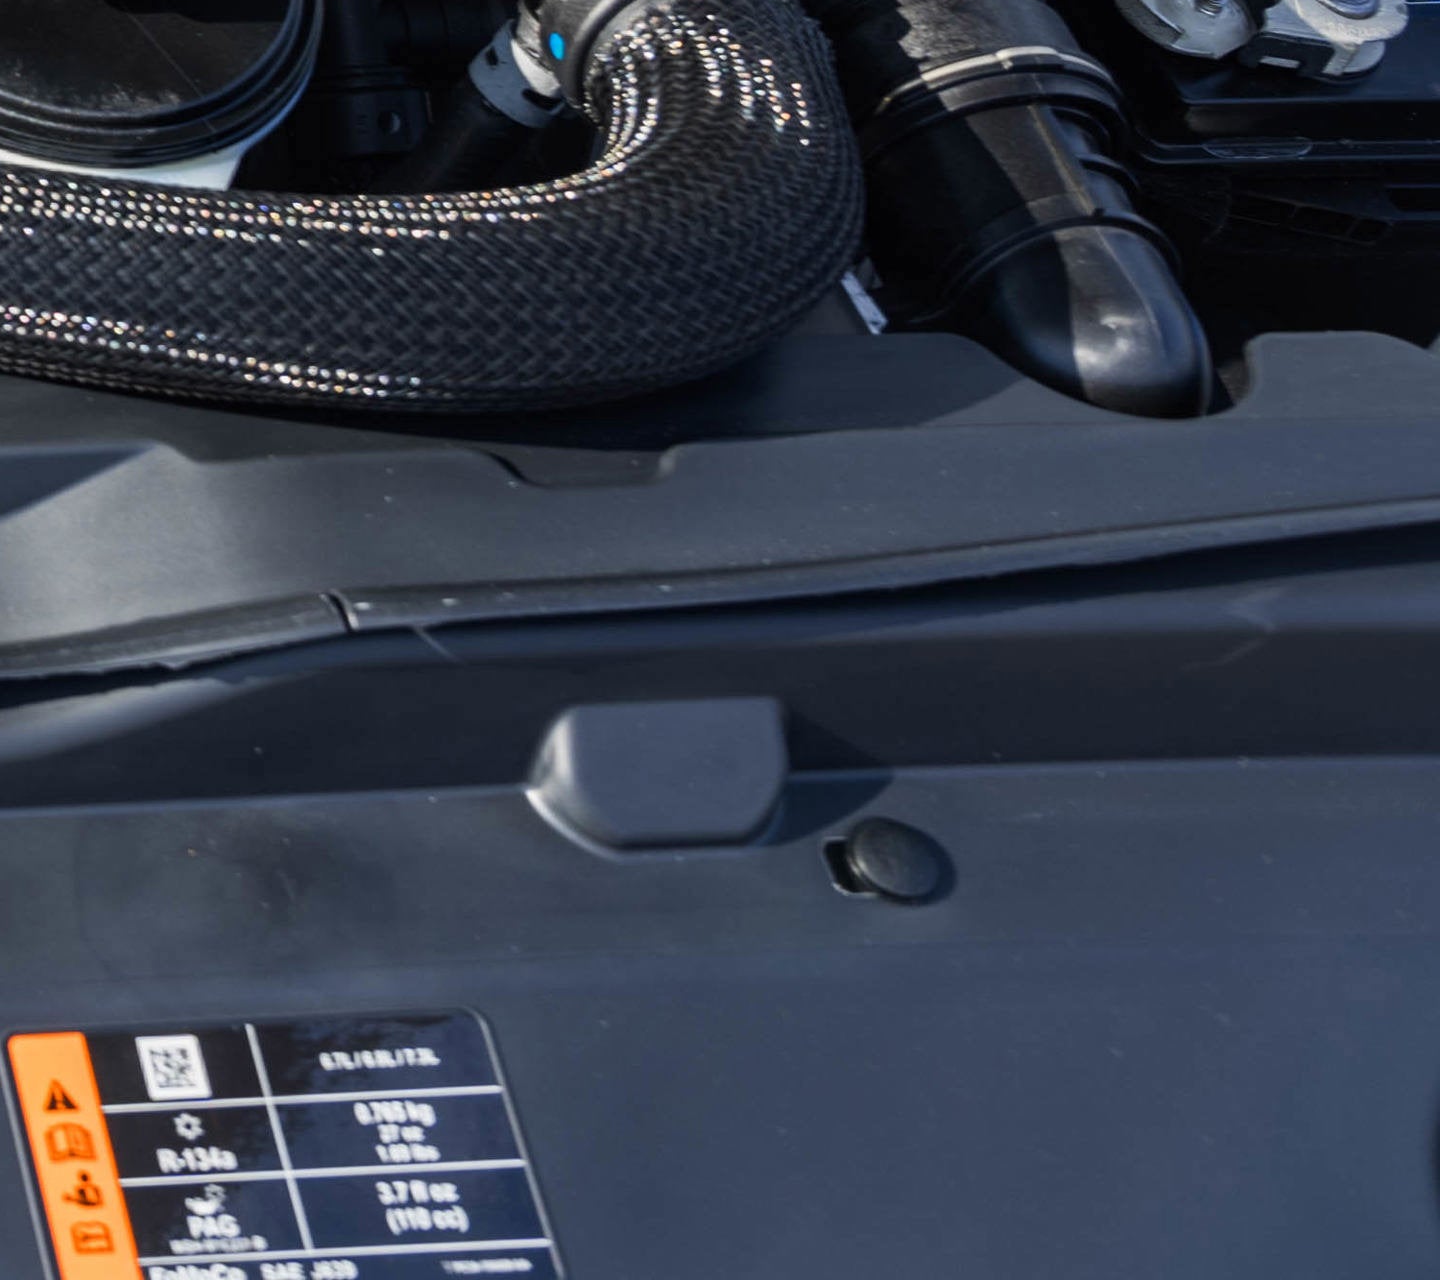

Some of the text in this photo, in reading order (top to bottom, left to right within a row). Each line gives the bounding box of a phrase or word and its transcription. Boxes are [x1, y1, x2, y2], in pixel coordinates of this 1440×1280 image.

[157, 1146, 238, 1174] R-134a
[376, 1180, 407, 1206] 3.7
[429, 1182, 460, 1203] oz
[187, 1214, 241, 1239] PAG
